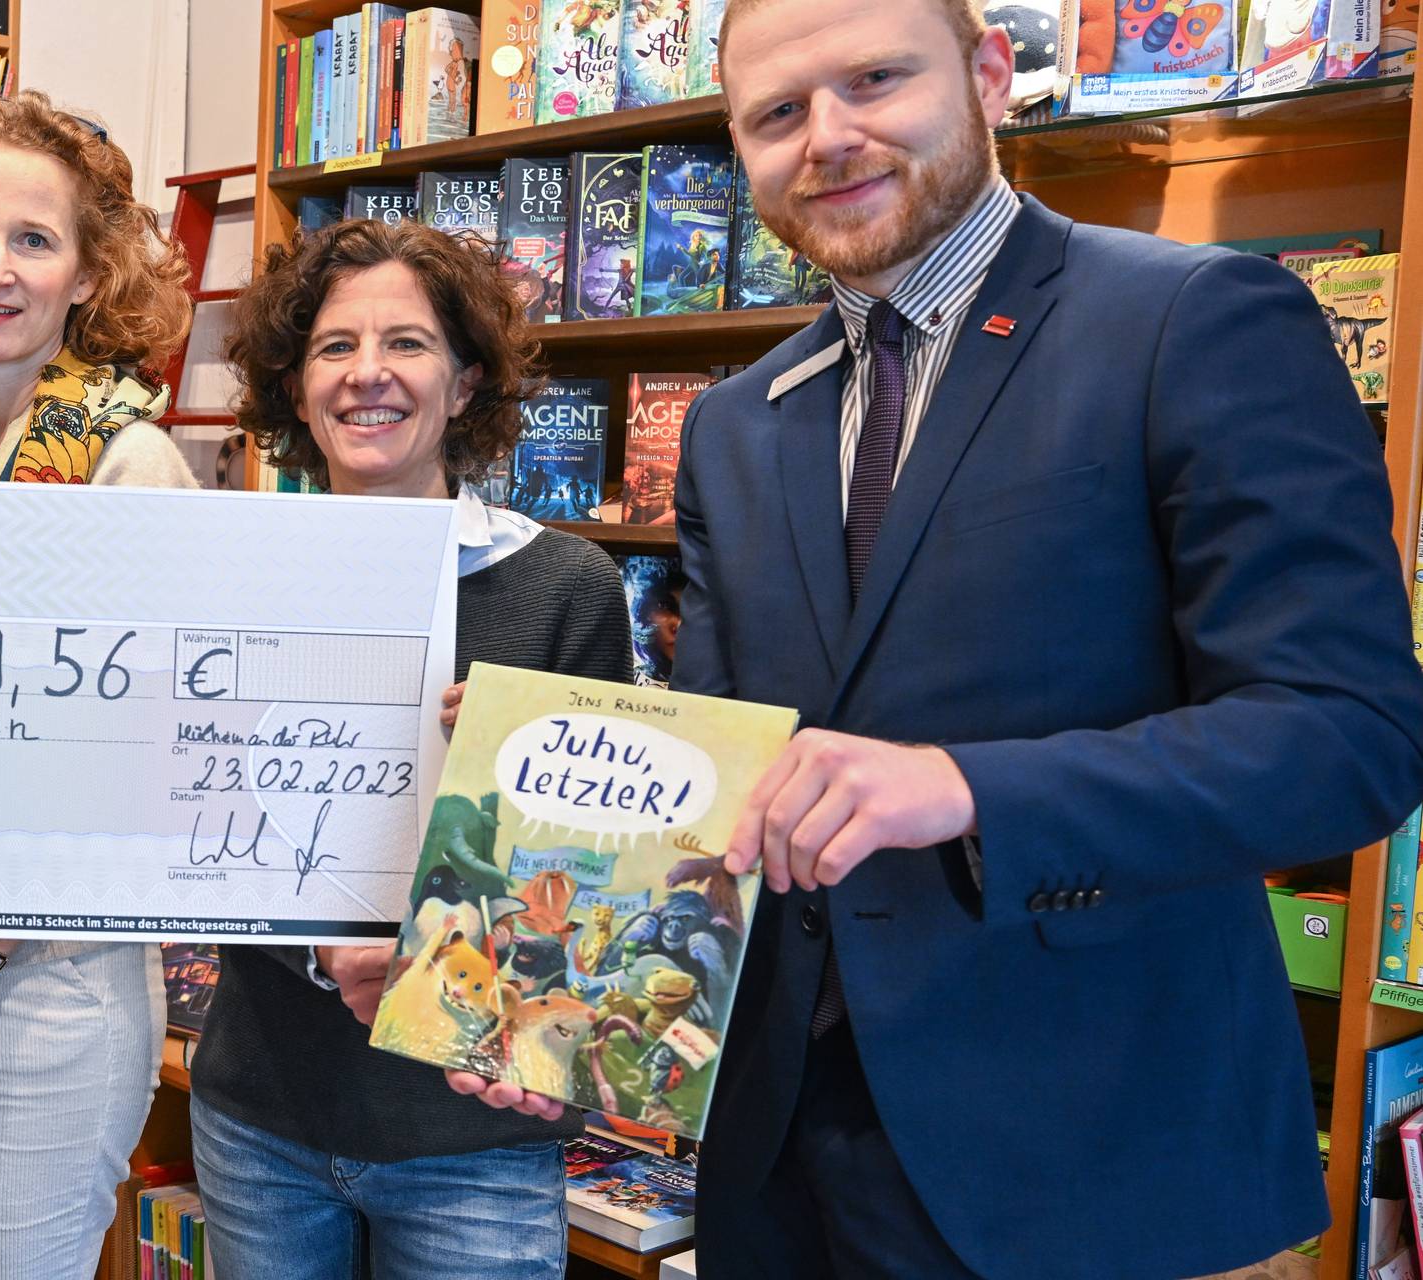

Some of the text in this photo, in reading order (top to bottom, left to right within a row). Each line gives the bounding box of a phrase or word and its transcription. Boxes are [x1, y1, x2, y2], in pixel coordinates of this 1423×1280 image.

[1354, 0, 1364, 42] Mein alle
[333, 32, 346, 78] KRABAT
[348, 29, 360, 76] KRABAT
[1153, 44, 1225, 73] Knisterbuch
[1085, 76, 1106, 84] mini
[1083, 84, 1109, 93] steps
[1113, 87, 1208, 96] Mein erstes Knisterbuch
[333, 155, 373, 169] Jugendbuch
[522, 168, 563, 181] KEE
[436, 180, 499, 195] KEEPE
[522, 181, 562, 200] LO
[686, 176, 705, 193] Die
[366, 196, 416, 209] KEEP
[436, 193, 492, 213] LOS
[520, 200, 563, 214] CIT
[655, 194, 725, 213] verborgenen
[434, 212, 499, 225] CITIE
[530, 214, 545, 222] Das
[1319, 277, 1385, 296] 50 Dinosaurier
[570, 387, 592, 396] LANE
[645, 382, 681, 391] ANDREW
[521, 405, 609, 427] AGENT
[627, 401, 690, 424] AGE
[519, 428, 604, 441] MPOSSIBLE
[631, 426, 681, 439] IMPOS
[183, 633, 232, 646] Währung
[245, 635, 280, 647] Betrag
[182, 648, 233, 699] €
[568, 691, 678, 717] JENS RASSMUS
[248, 733, 269, 746] an
[299, 719, 361, 748] Ruhr
[171, 746, 188, 756] Ort
[543, 719, 652, 775] Juhu,
[193, 756, 414, 798] 23.02.2023
[170, 792, 205, 801] Datum
[532, 856, 559, 871] NEUE
[168, 870, 227, 881] Unterschrift
[26, 916, 42, 927] als
[45, 916, 84, 928] Scheck
[87, 917, 101, 928] im
[103, 917, 135, 929] Sinne
[138, 918, 157, 929] des
[160, 919, 247, 933] Scheckgesetzes
[250, 920, 273, 933] gilt.
